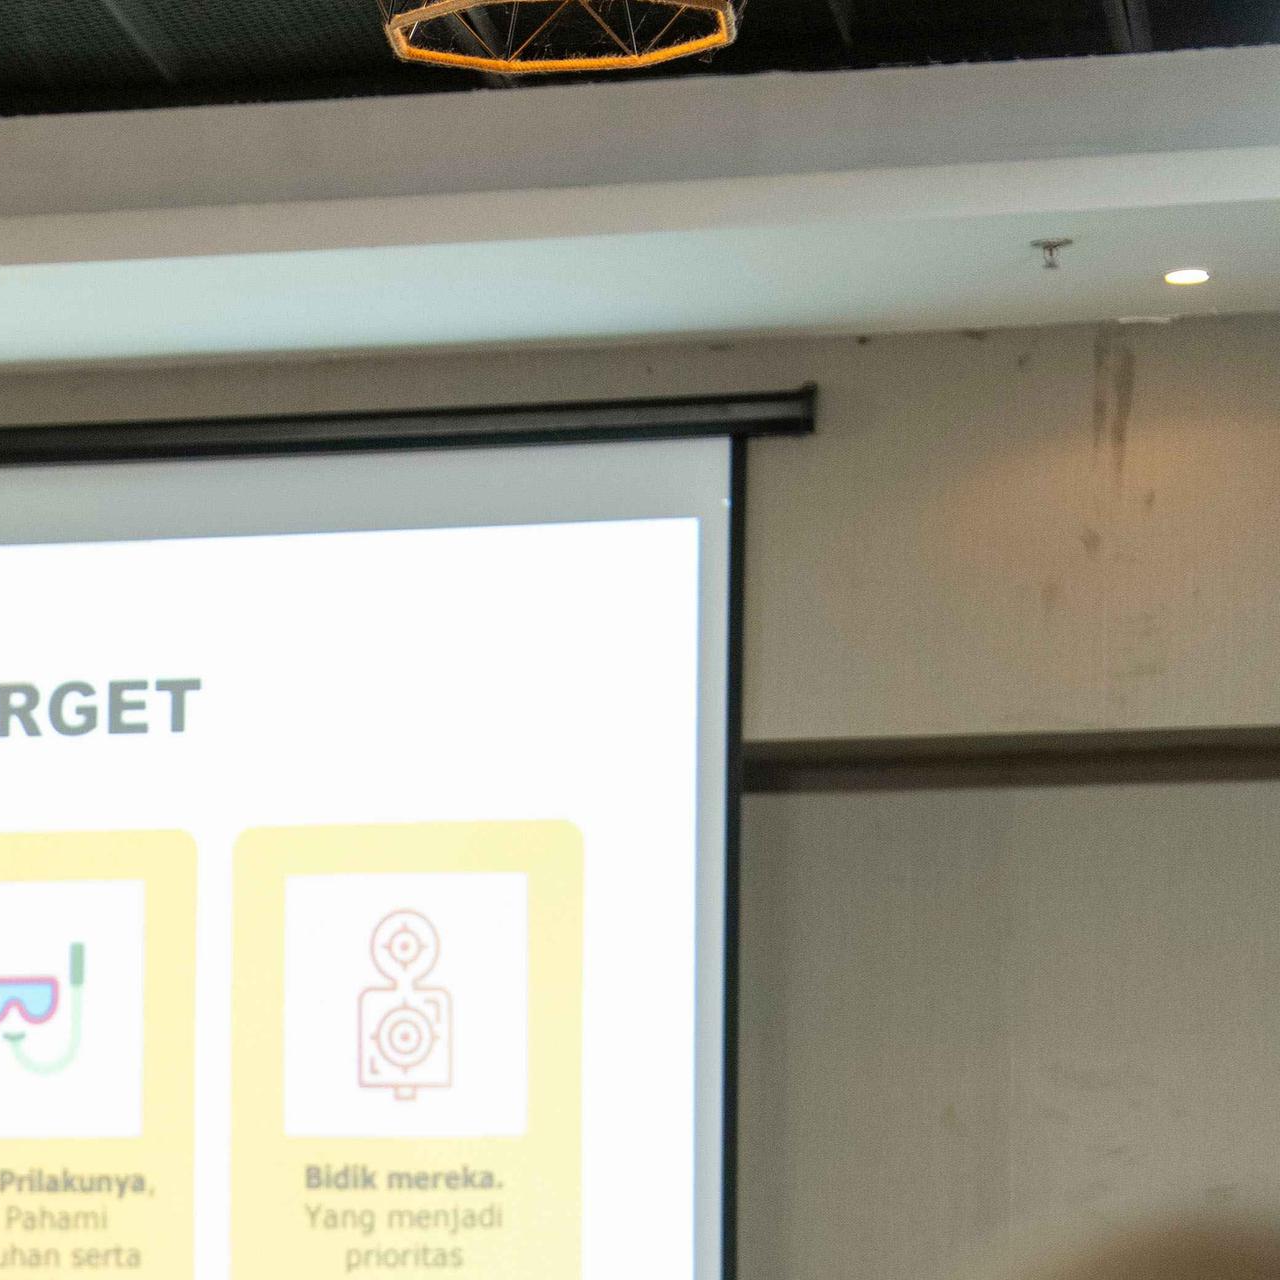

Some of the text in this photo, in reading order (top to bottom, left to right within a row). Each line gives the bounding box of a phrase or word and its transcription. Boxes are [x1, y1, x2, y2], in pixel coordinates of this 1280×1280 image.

[304, 1164, 504, 1191] Bidik mereka.
[5, 1204, 108, 1232] Pahami
[304, 1202, 504, 1236] Yang menjadi
[72, 1244, 142, 1269] serta
[345, 1243, 464, 1273] prioritas
